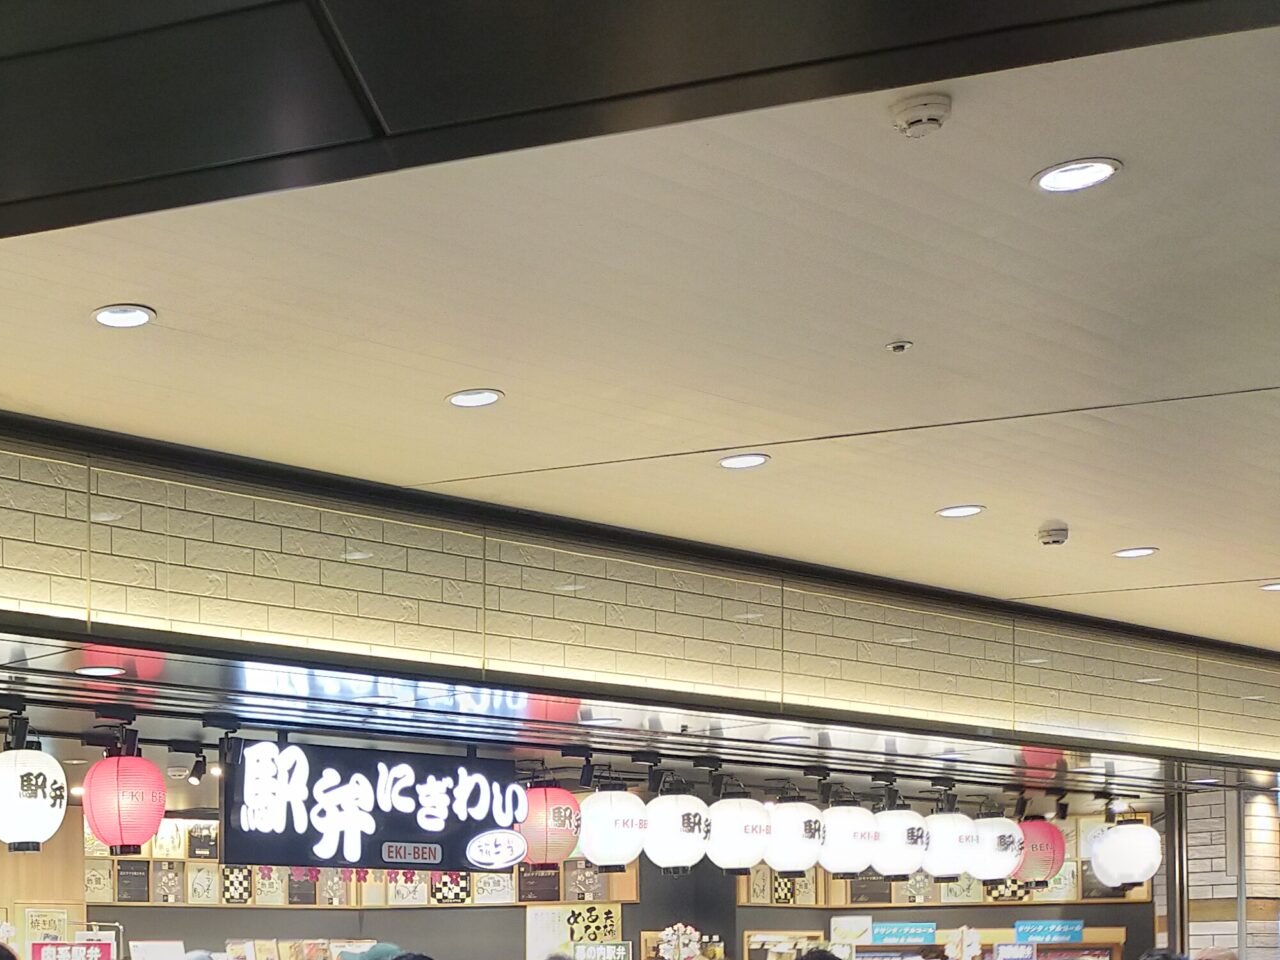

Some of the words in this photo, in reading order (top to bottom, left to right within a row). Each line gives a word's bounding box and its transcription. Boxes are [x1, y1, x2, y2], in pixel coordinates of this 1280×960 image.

[19, 772, 65, 809] 駅弁
[240, 741, 528, 862] 駅弁にぎわい
[387, 845, 437, 860] EKI-BEN
